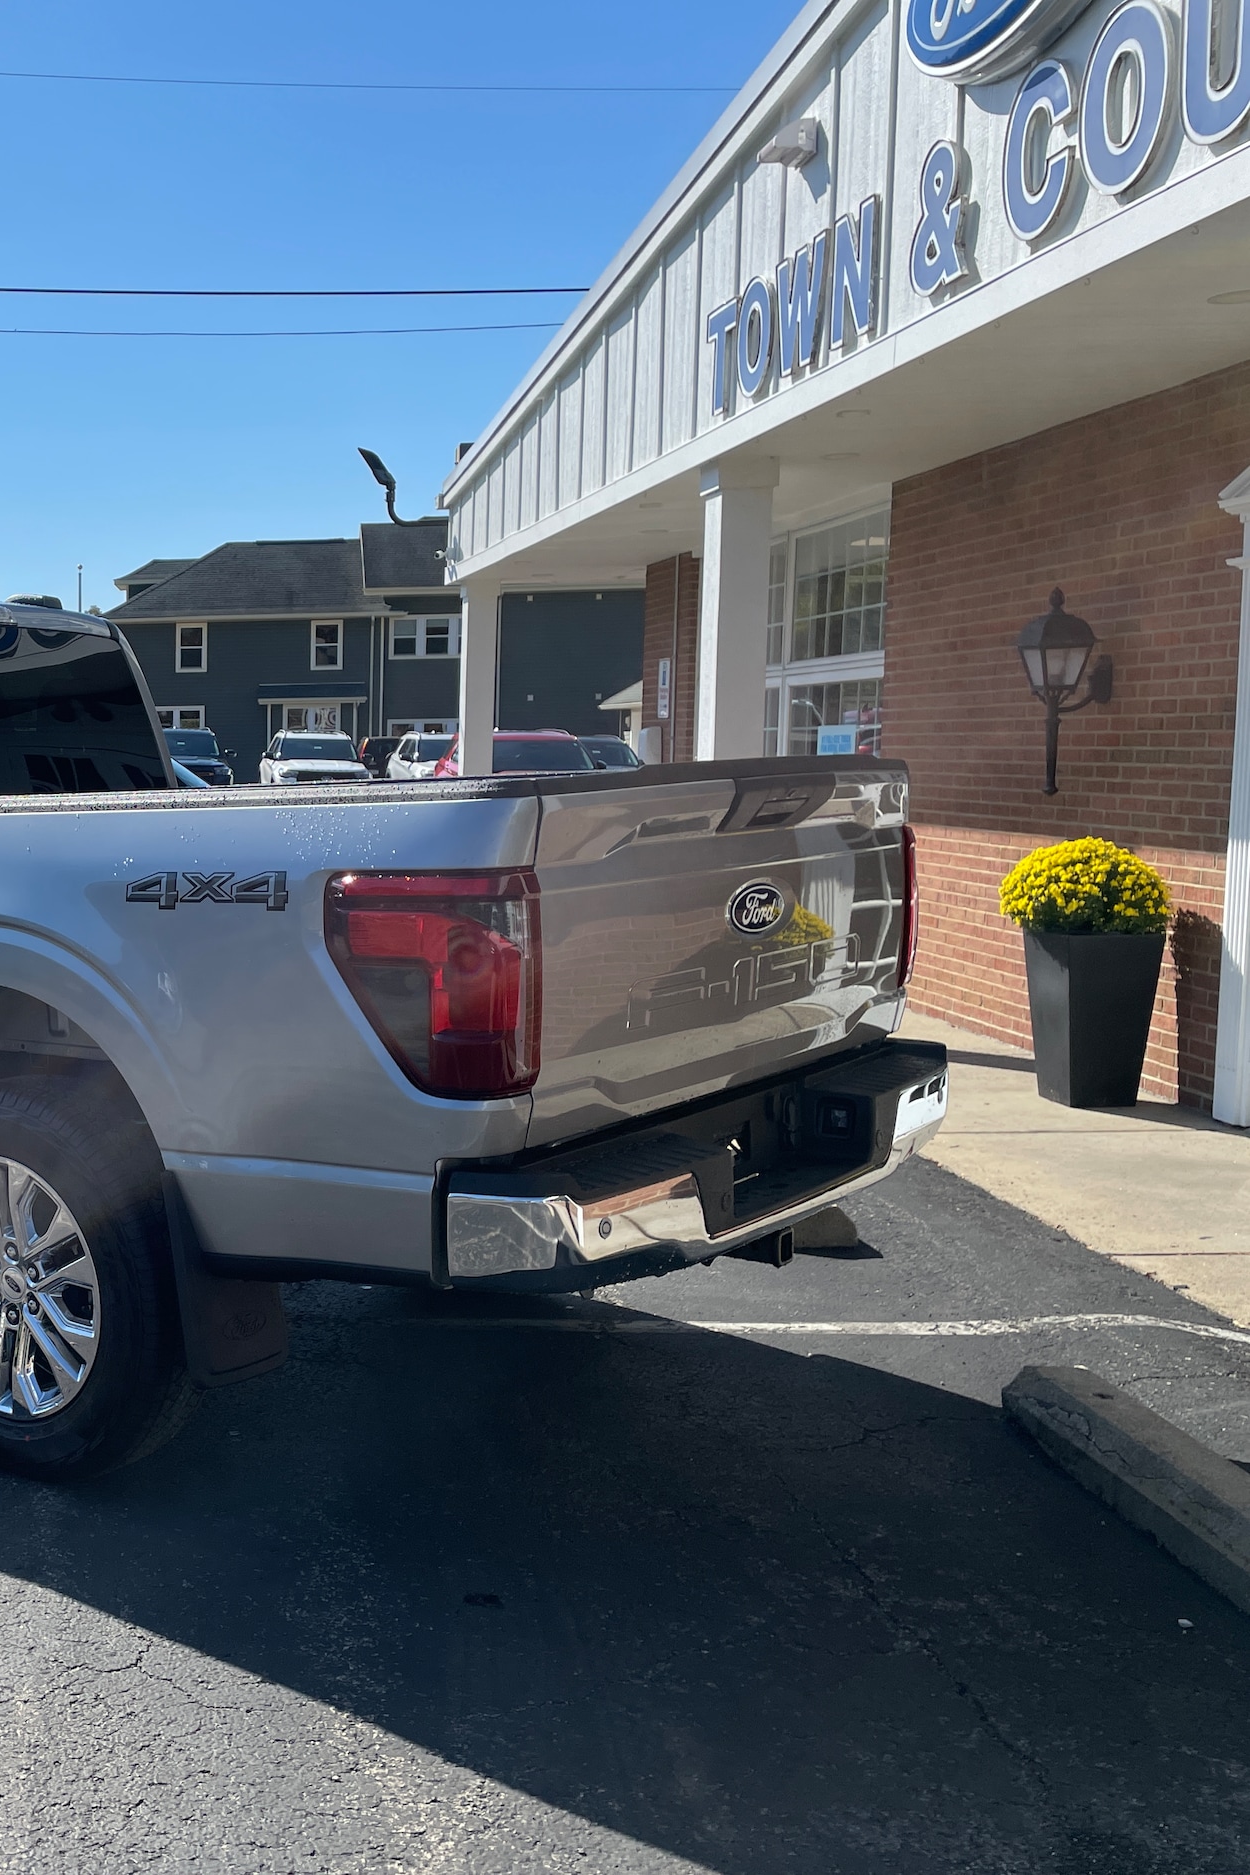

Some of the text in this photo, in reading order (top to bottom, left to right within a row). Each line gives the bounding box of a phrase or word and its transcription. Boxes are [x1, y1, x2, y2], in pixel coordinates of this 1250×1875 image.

[706, 194, 882, 417] TOWN
[910, 139, 969, 298] &
[740, 891, 779, 927] Ford
